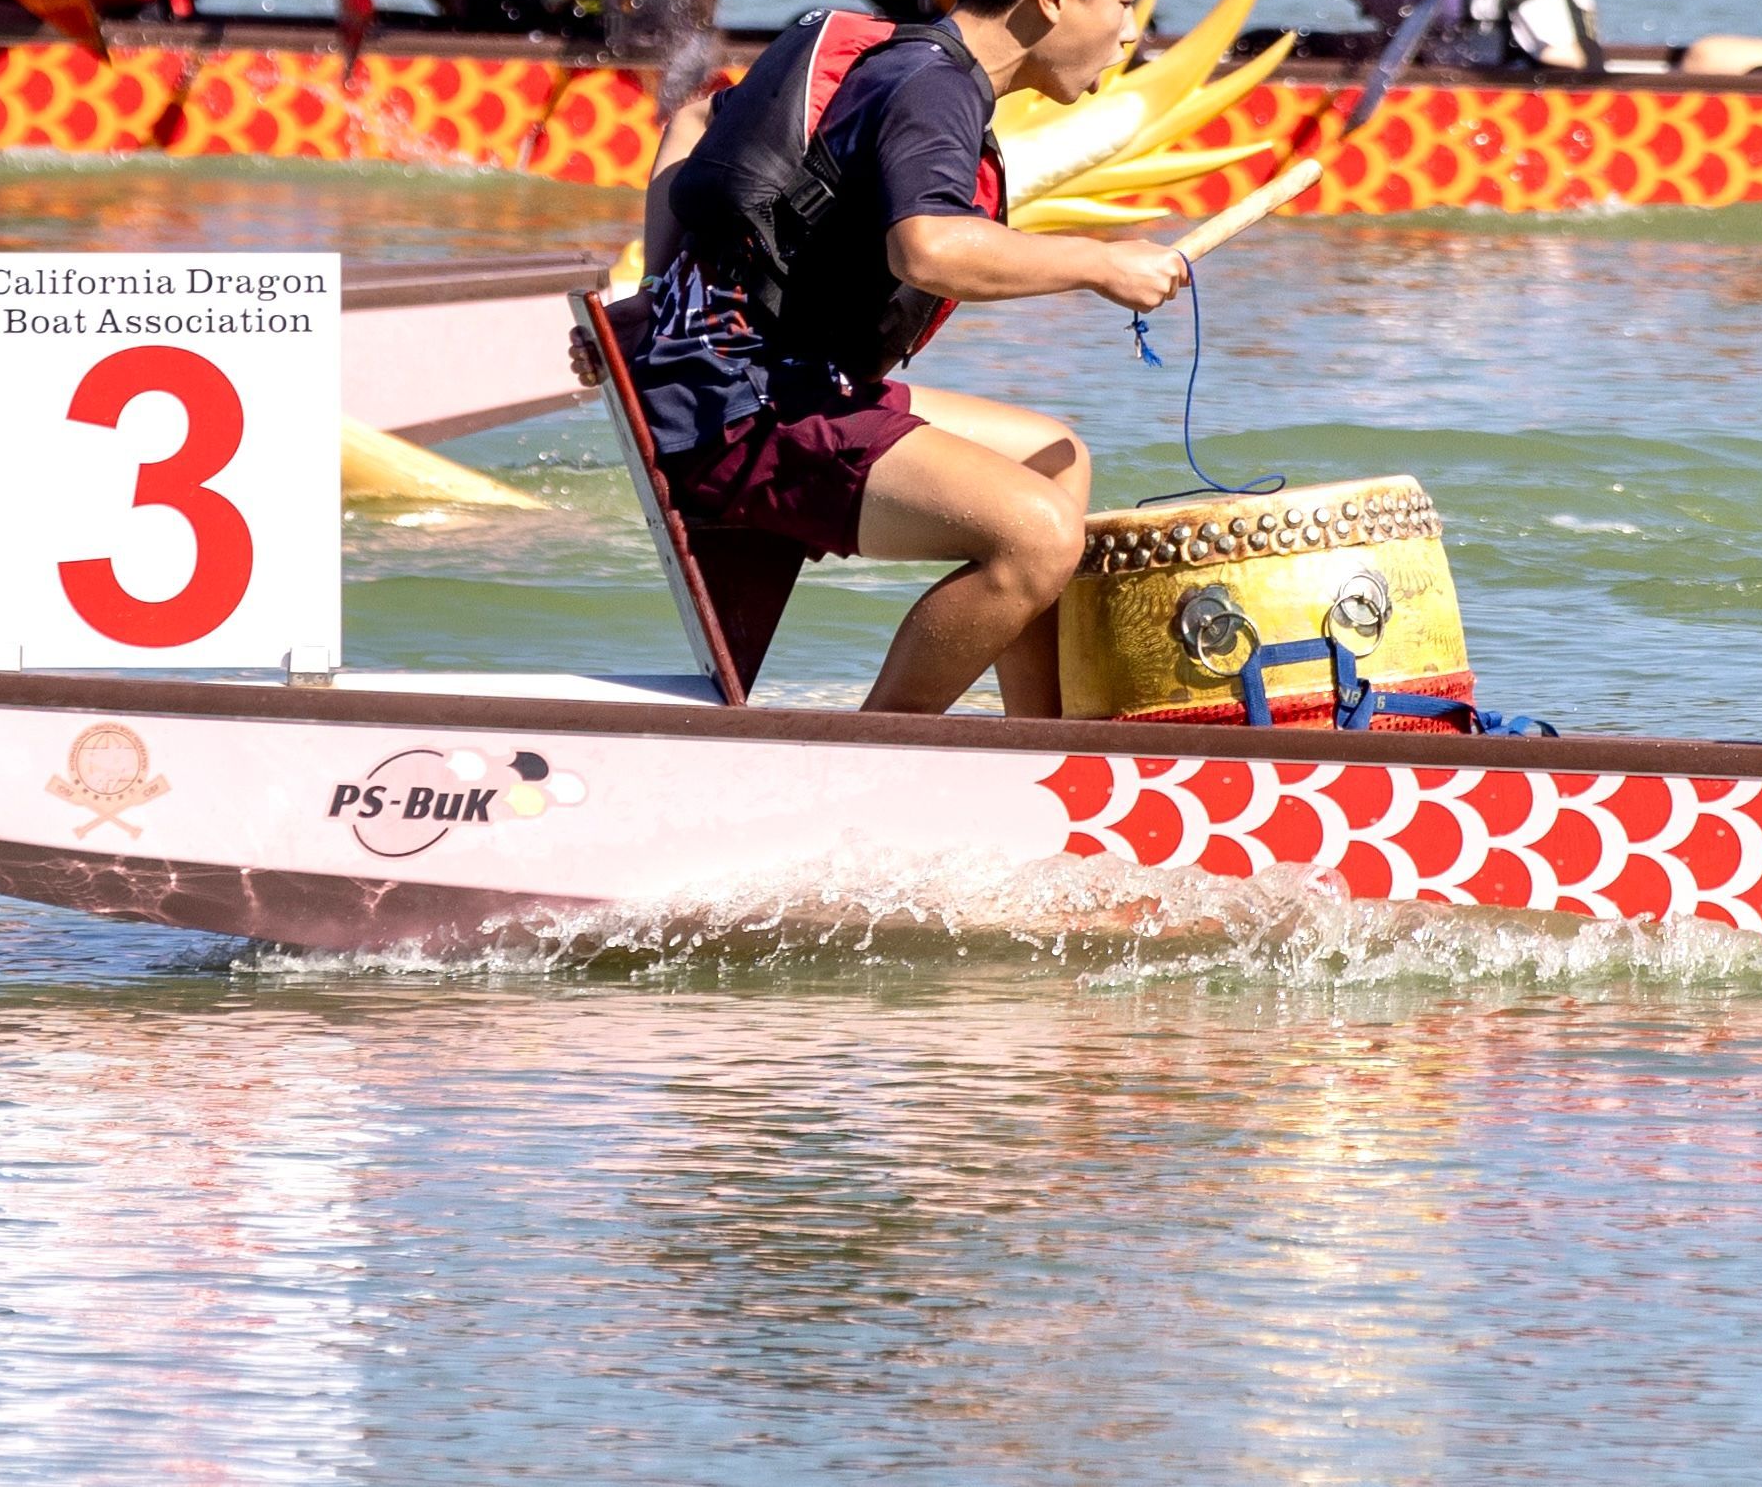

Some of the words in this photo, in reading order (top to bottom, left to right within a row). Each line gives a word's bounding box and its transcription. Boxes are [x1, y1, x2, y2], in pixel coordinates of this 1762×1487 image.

[186, 268, 327, 301] Dragon
[3, 308, 87, 334] Boat
[95, 307, 313, 334] Association
[57, 345, 254, 649] 3
[329, 784, 498, 822] PS-BuK
